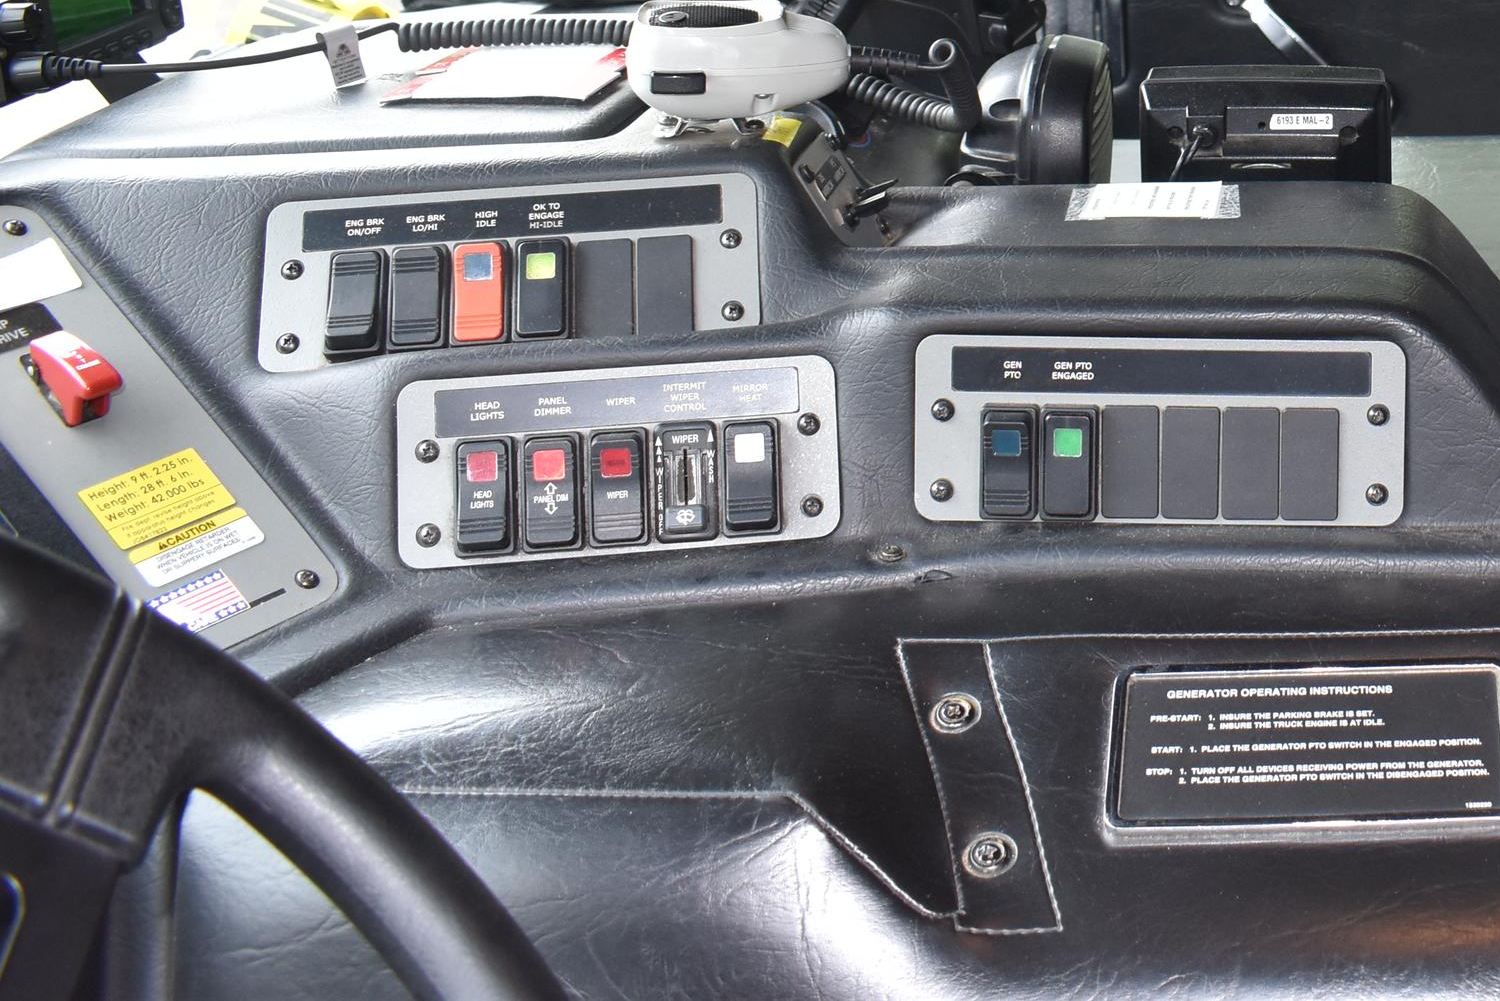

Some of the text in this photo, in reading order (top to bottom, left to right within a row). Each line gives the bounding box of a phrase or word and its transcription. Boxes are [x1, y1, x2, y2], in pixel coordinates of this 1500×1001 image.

[533, 202, 561, 211] OK TO
[406, 213, 446, 224] ENG BRK
[475, 210, 498, 220] HIGH
[528, 211, 565, 220] ENGAGE
[345, 217, 385, 228] ENG BRK
[412, 223, 439, 232] LO/HI
[476, 219, 497, 228] IDLE
[529, 220, 564, 229] HI-IDLE
[347, 227, 382, 237] ON/OFF
[1003, 361, 1022, 369] GEN
[1054, 362, 1092, 370] GEN PTO
[1004, 371, 1021, 379] PTO
[1051, 371, 1095, 380] ENGAGED
[662, 382, 707, 392] INTERMIT
[732, 383, 769, 393] MIRROR
[538, 397, 568, 407] PANEL
[606, 397, 636, 407] WIPER
[670, 393, 700, 402] WIPER
[739, 394, 763, 403] HEAT
[474, 401, 501, 411] HEAD
[663, 402, 707, 413] CONTROL
[470, 410, 505, 422] LIGHTS
[534, 406, 572, 417] DIMMER
[672, 434, 700, 445] WIPER
[706, 449, 716, 484] WASH
[88, 481, 130, 501] Height:
[130, 476, 138, 484] 9
[152, 461, 177, 475] 2.25
[96, 491, 140, 512] Length:
[140, 484, 155, 494] 28
[170, 474, 177, 482] 6
[655, 467, 664, 510] WIPER
[473, 490, 492, 499] HEAD
[533, 494, 569, 504] PANEL DIM
[606, 490, 629, 500] WIPER
[104, 501, 150, 522] Weight:
[187, 478, 205, 489] lbs
[470, 500, 495, 510] LIGHTS
[166, 520, 217, 546] CAUTION
[156, 542, 193, 562] DISENGAGE
[194, 526, 230, 545] RETARDER
[158, 558, 177, 569] WHEN
[179, 545, 205, 560] VEHICLE
[224, 530, 238, 540] WET
[173, 553, 205, 570] SLIPPERY
[1167, 685, 1393, 699] GENERATOR OPERATING INSTRUCTIONS
[1150, 714, 1202, 723] PRE-START:
[1219, 713, 1252, 721] INSURE
[1254, 712, 1272, 720] THE
[1273, 711, 1312, 720] PARKING
[1346, 710, 1355, 718] IS
[1219, 722, 1252, 730] INSURE
[1254, 721, 1272, 729] THE
[1273, 720, 1303, 728] TRUCK
[1305, 719, 1338, 728] ENGINE
[1339, 719, 1349, 727] IS
[1363, 718, 1385, 726] IDLE.
[1151, 746, 1183, 754] START:
[1201, 745, 1231, 753] PLACE
[1232, 744, 1250, 752] THE
[1251, 742, 1307, 751] GENERATOR
[1328, 741, 1362, 749] SWITCH
[1364, 740, 1373, 748] IN
[1374, 740, 1392, 748] THE
[1394, 739, 1437, 748] ENGAGED
[1439, 738, 1482, 747] POSITION.
[1146, 768, 1173, 776] STOP:
[1191, 767, 1216, 775] TURN
[1217, 766, 1235, 774] OFF
[1237, 765, 1254, 774] ALL
[1256, 764, 1295, 773] DEVICES
[1296, 763, 1344, 772] RECEIVING
[1345, 762, 1378, 770] POWER
[1380, 761, 1406, 770] FROM
[1407, 761, 1425, 769] THE
[1426, 759, 1484, 768] GENERATOR.
[1178, 769, 1490, 785] 2. PLACE THE GENERATOR PTO SWITCH IN THE DISENGAGED POSITION.
